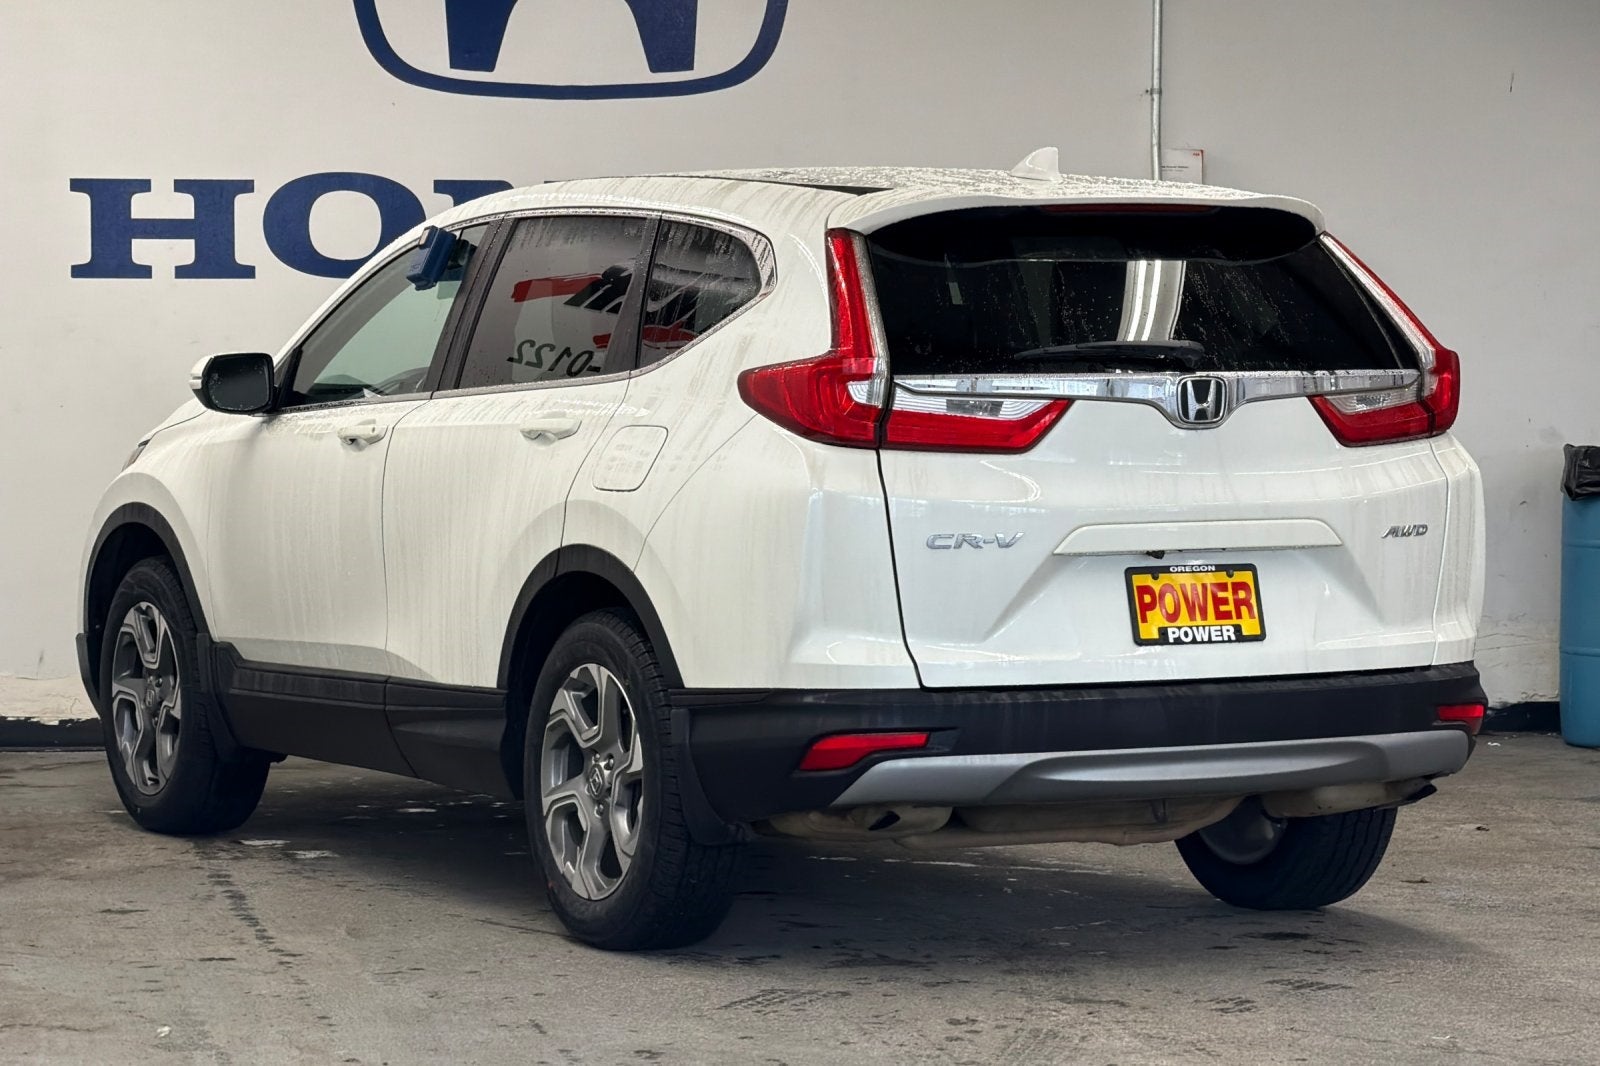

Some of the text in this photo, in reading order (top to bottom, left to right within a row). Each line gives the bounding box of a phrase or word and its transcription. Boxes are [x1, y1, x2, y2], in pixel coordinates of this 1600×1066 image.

[70, 172, 514, 279] HO
[1381, 524, 1428, 539] AWD
[926, 532, 1024, 550] CR-V
[1169, 565, 1216, 573] OREGON
[1136, 581, 1256, 624] POWER
[1167, 625, 1236, 643] POWER
